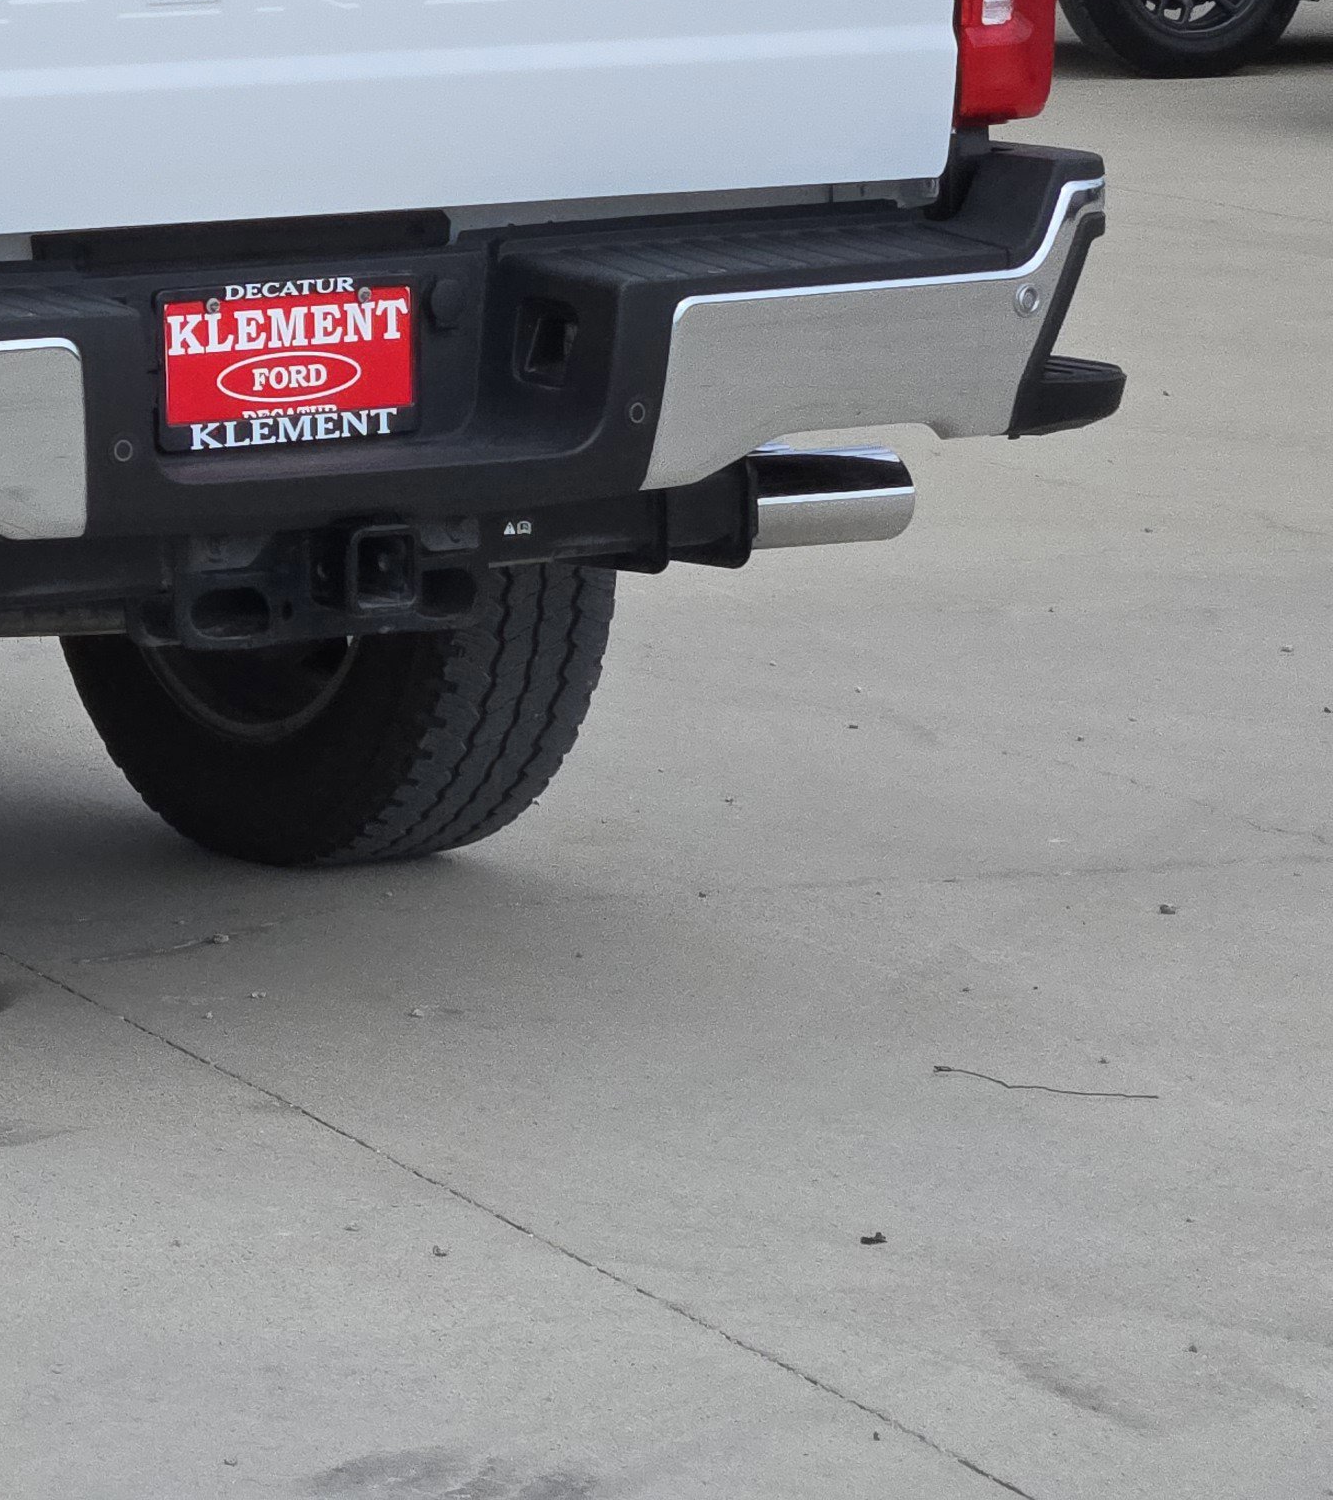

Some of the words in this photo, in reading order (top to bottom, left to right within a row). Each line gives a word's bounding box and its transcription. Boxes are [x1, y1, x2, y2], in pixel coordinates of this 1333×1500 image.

[224, 276, 355, 302] DECATUR
[166, 297, 410, 357] KLEMENT
[251, 363, 328, 392] FORD
[189, 407, 398, 451] KLEMENT
